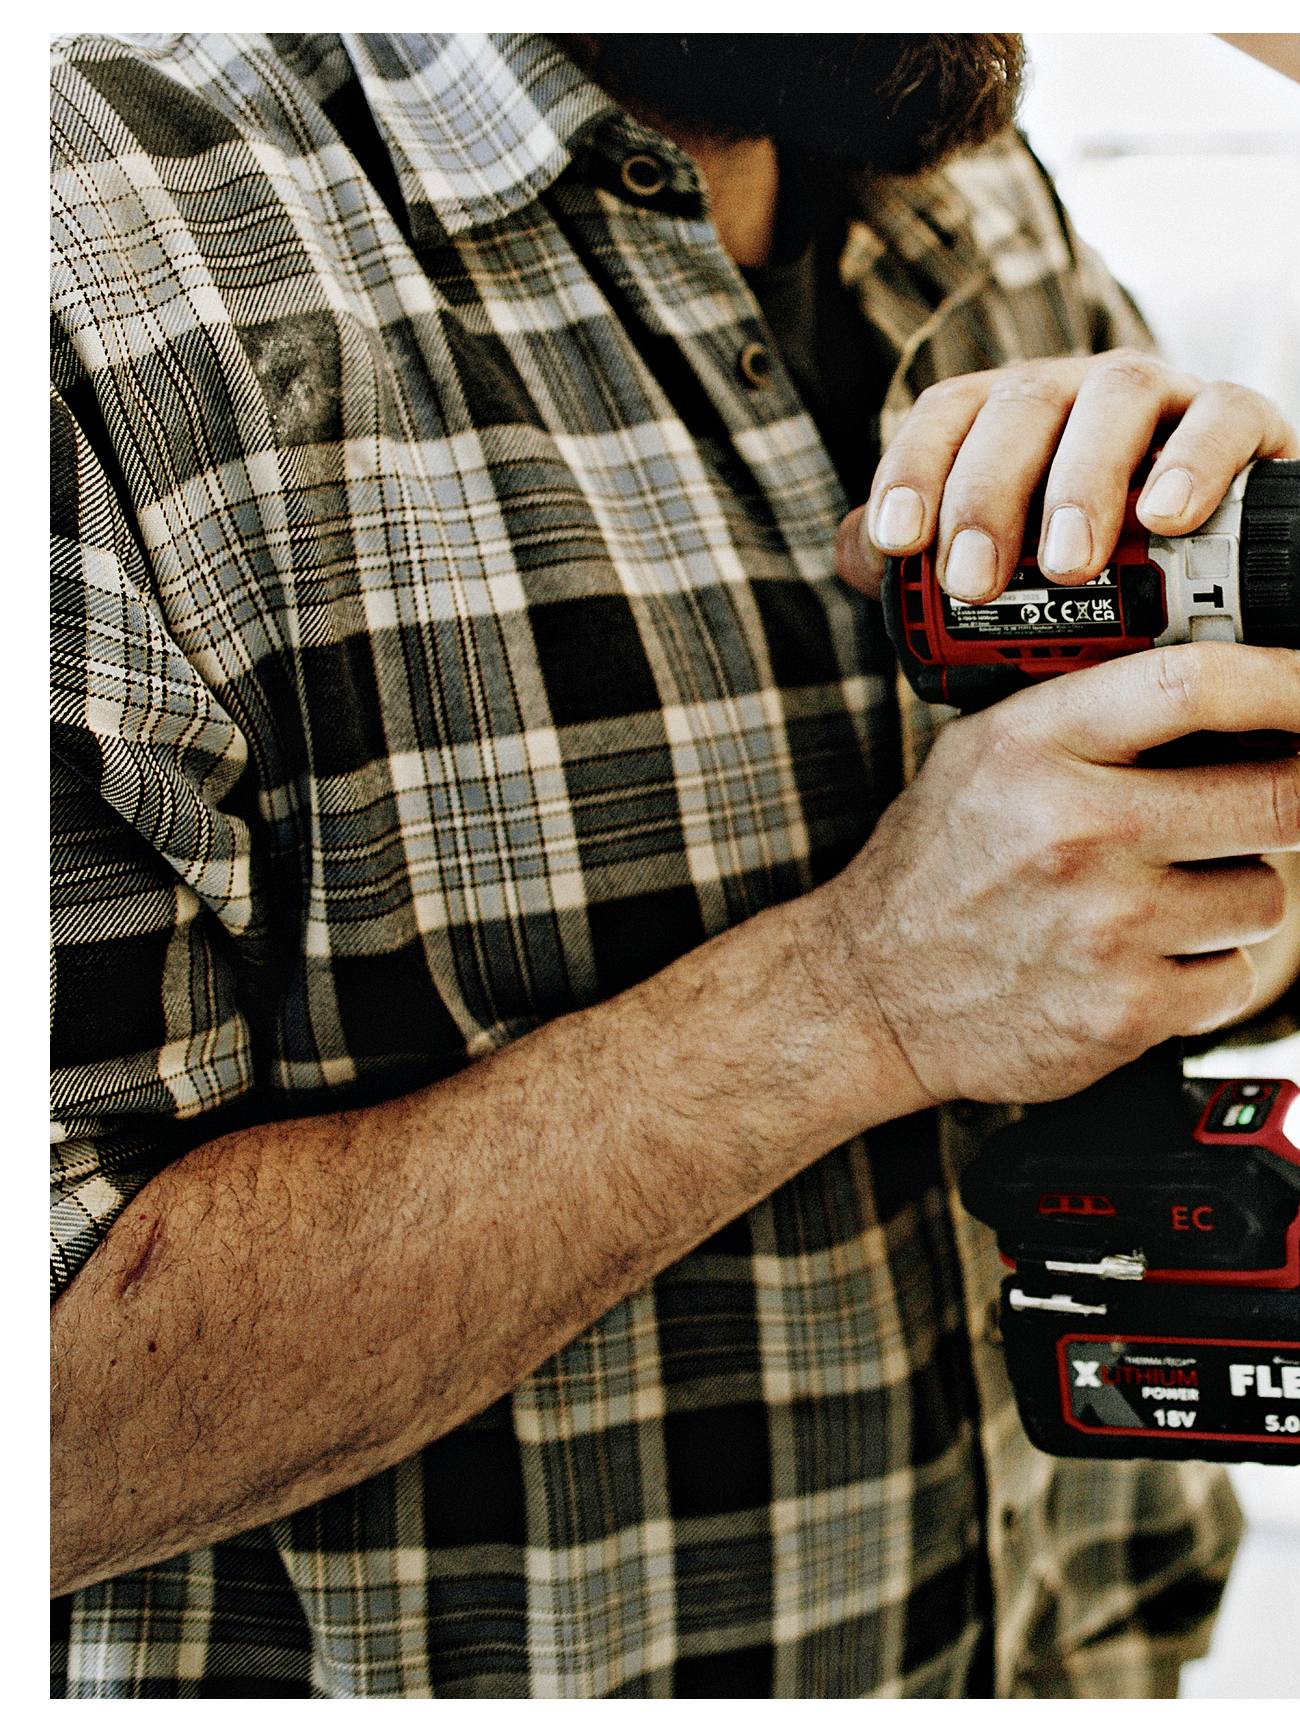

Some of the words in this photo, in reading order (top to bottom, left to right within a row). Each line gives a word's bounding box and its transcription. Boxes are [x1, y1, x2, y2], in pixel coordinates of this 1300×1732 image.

[1043, 600, 1075, 623] CE
[1091, 598, 1113, 610] UK
[1092, 610, 1115, 621] CA
[1170, 1205, 1215, 1232] EC
[1142, 1386, 1200, 1402] POWER
[1153, 1409, 1197, 1428] 18V
